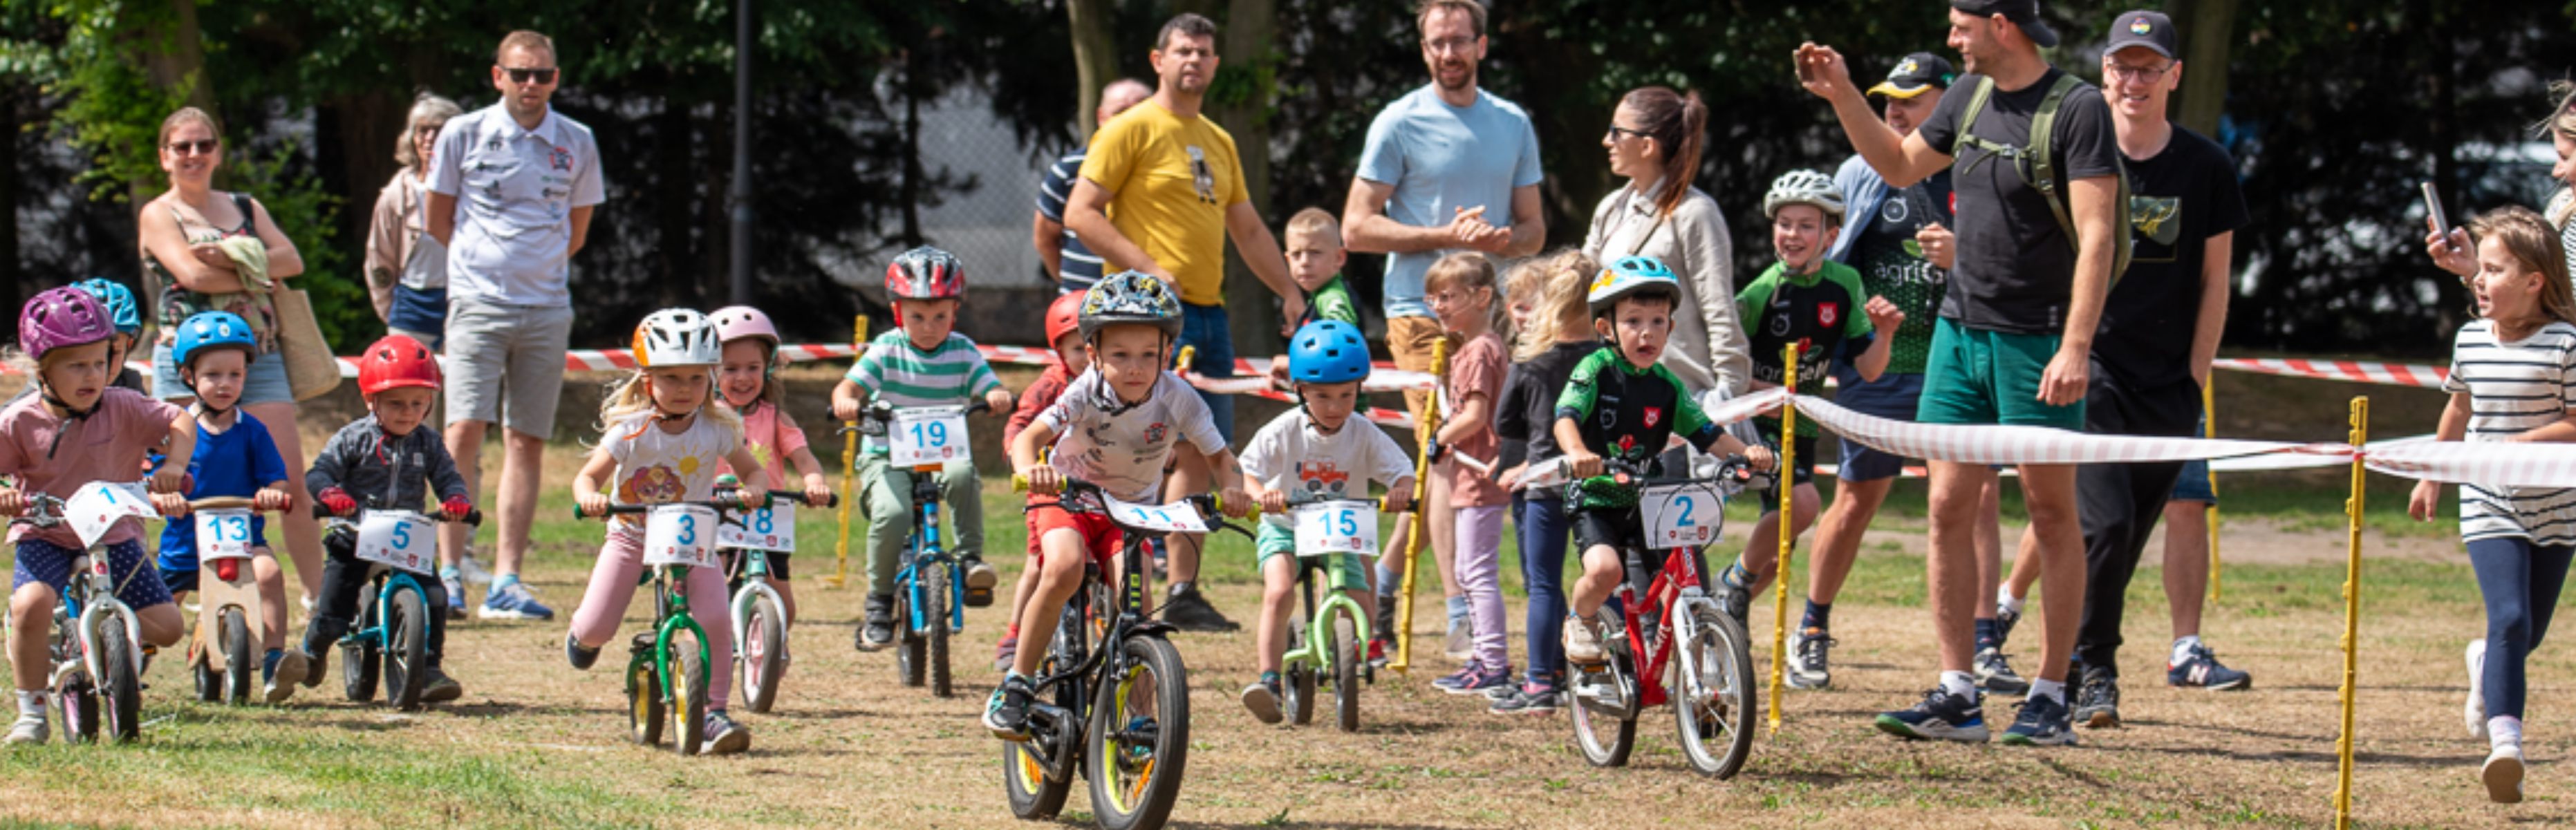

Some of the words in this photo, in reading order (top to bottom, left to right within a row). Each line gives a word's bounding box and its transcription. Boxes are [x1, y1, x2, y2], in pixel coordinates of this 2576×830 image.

[910, 422, 946, 449] 19
[99, 487, 116, 504] 1
[741, 507, 774, 534] 18
[1130, 508, 1171, 522] 11
[1318, 509, 1357, 536] 15
[1674, 496, 1695, 527] 2
[208, 516, 248, 541] 13
[391, 521, 412, 550] 5
[678, 514, 696, 545] 3
